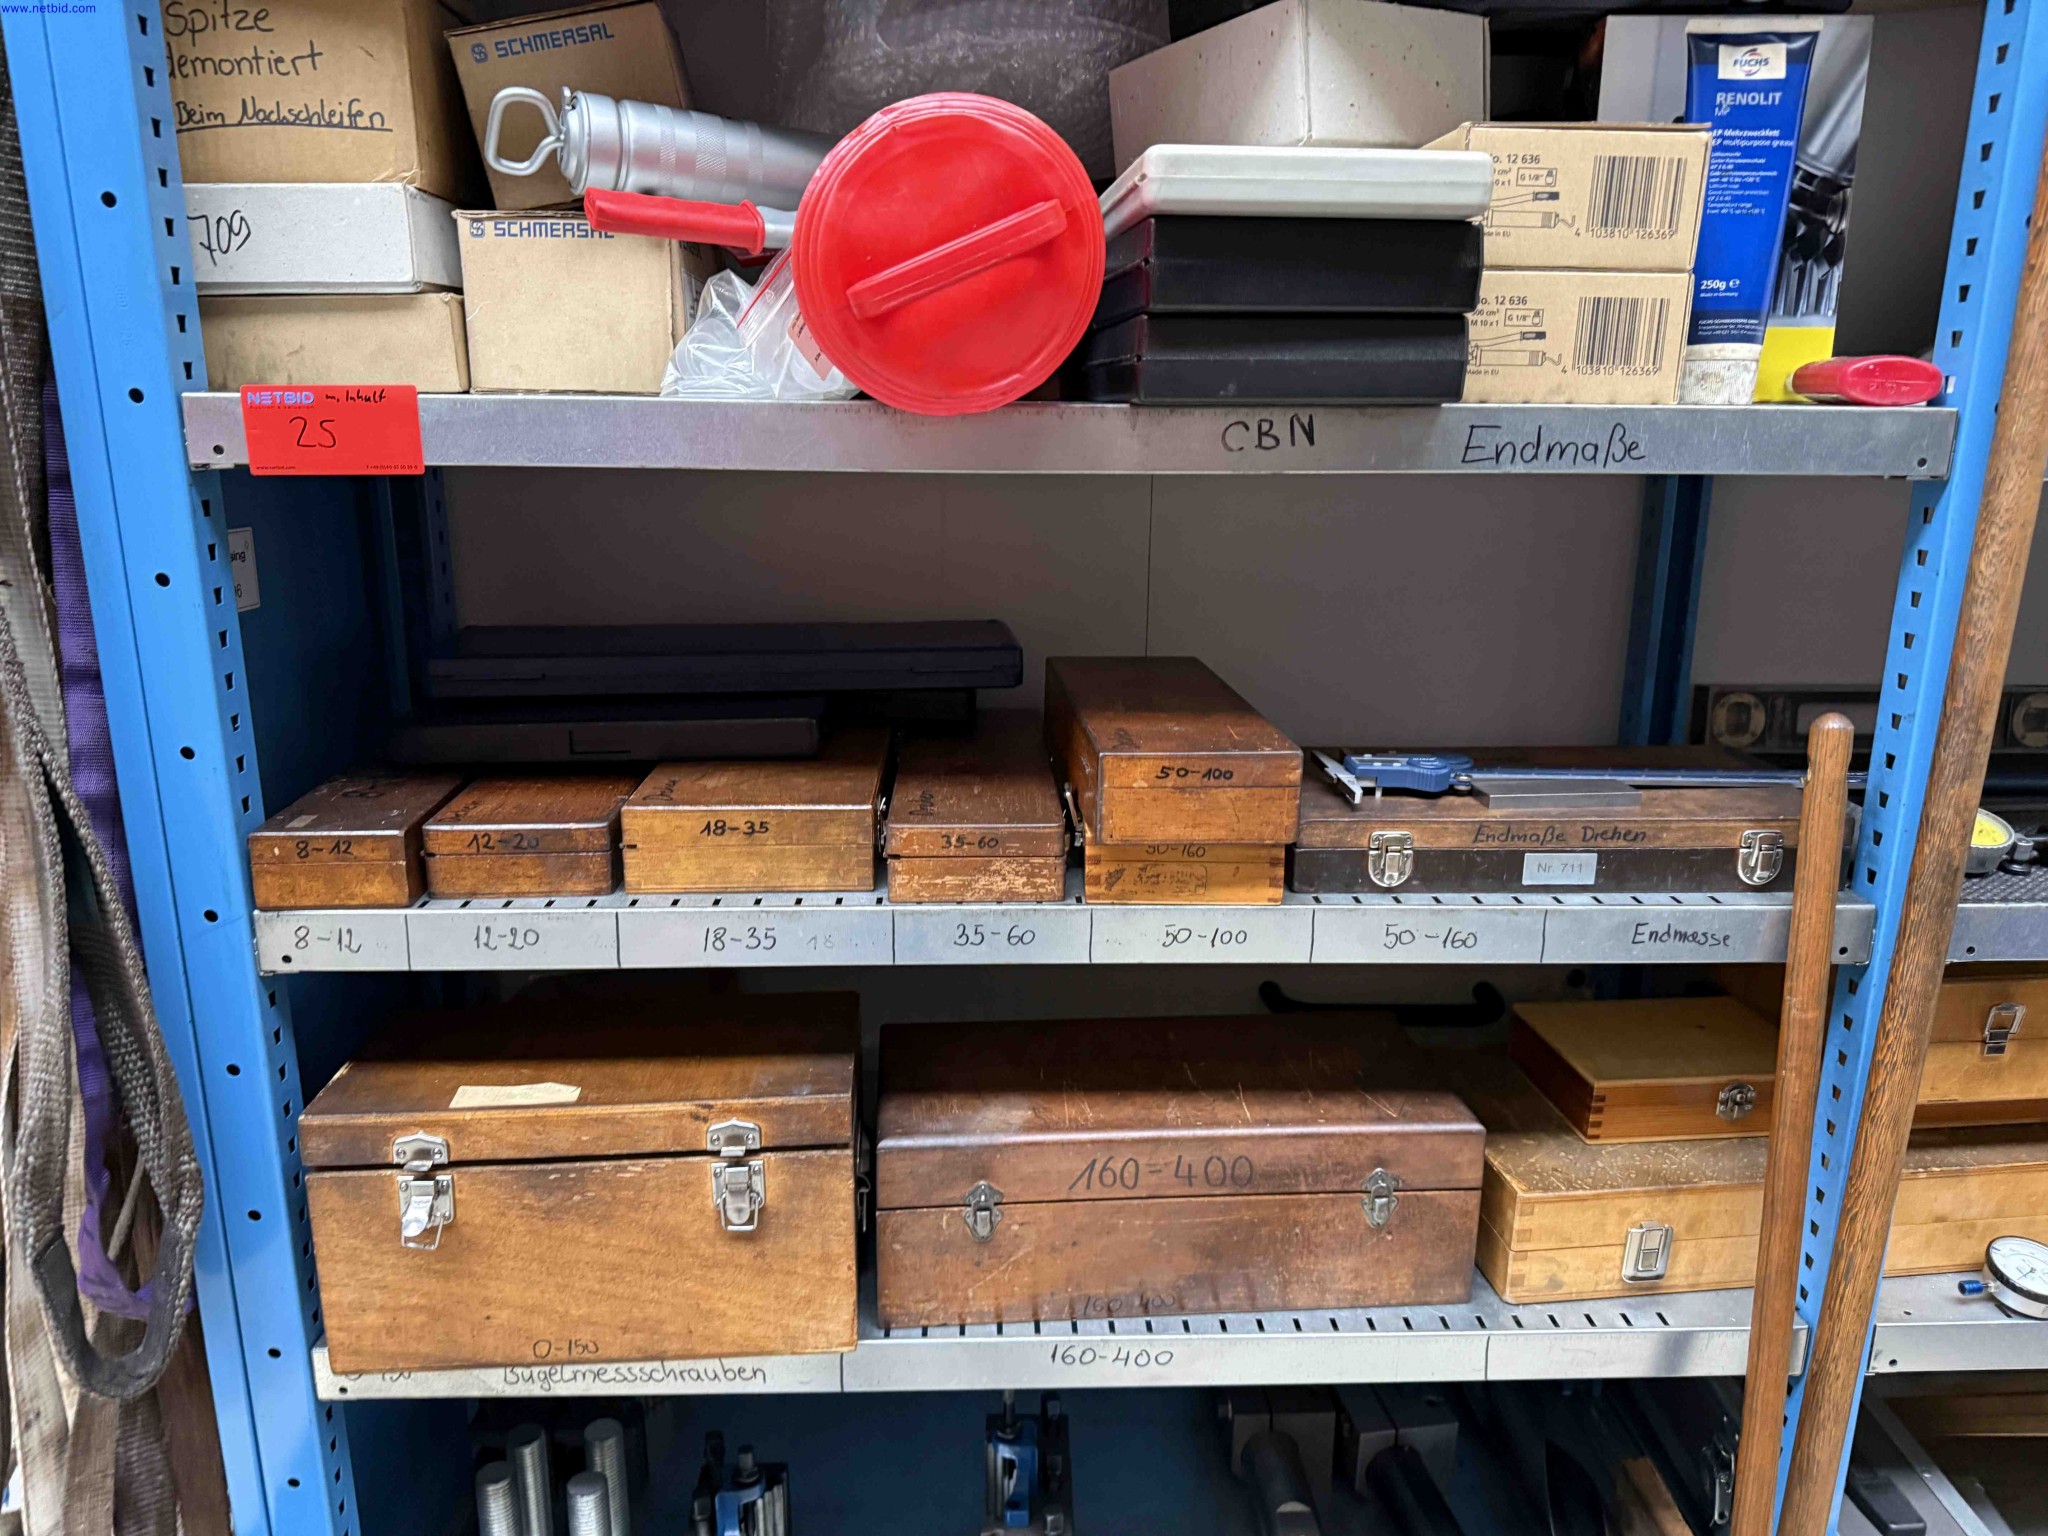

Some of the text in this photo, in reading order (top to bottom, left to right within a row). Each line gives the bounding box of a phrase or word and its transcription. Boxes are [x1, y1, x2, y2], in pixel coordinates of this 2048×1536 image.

[164, 1, 274, 47] Spitze
[494, 23, 615, 58] SCHMERSAL
[1733, 57, 1770, 67] FUCHS
[1716, 91, 1782, 105] RENOLIT
[176, 100, 226, 126] Beim
[1506, 153, 1518, 164] 12
[1521, 153, 1541, 164] 636
[186, 210, 252, 266] 709
[1574, 228, 1675, 239] 4 103810 126369
[1700, 279, 1727, 290] 250g
[1494, 295, 1506, 306] 12
[1509, 295, 1528, 306] 636
[1561, 365, 1660, 376] 4 103810 126369
[247, 391, 315, 405] NETBID
[288, 416, 337, 448] 25
[1220, 414, 1315, 452] CBN
[1461, 422, 1648, 469] Endmaße
[1154, 765, 1235, 782] 50-100
[699, 820, 770, 838] 18-35
[1473, 822, 1647, 847] Endmaße Drehen
[295, 839, 354, 858] 8-12
[466, 832, 541, 854] 12-20
[939, 833, 1000, 851] 35-60
[1537, 862, 1583, 873] Nr. 711
[293, 925, 363, 954] 8-12
[473, 924, 541, 951] 12-20
[703, 926, 777, 953] 18-35
[952, 923, 1037, 947] 35-60
[1161, 922, 1249, 948] 50-100
[1383, 922, 1479, 949] 50-160
[532, 1338, 600, 1360] 0-150
[1050, 1343, 1174, 1368] 160-400
